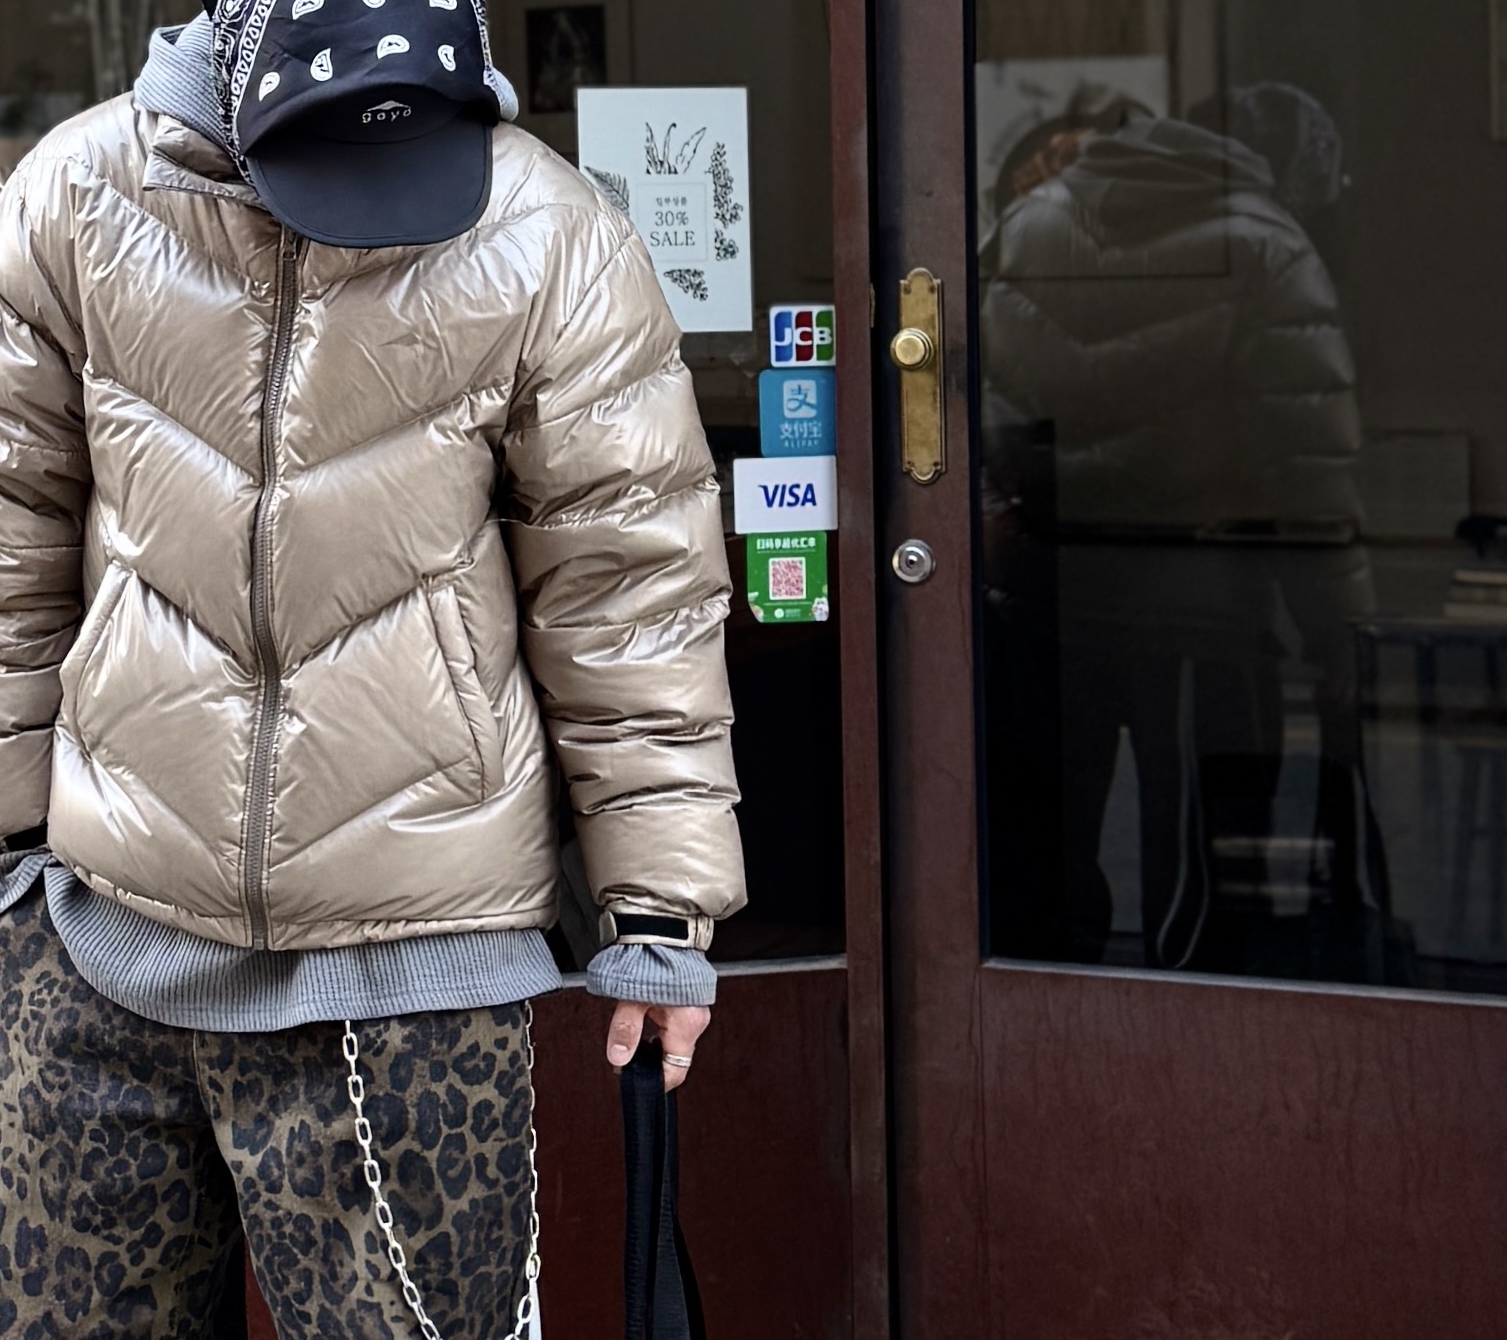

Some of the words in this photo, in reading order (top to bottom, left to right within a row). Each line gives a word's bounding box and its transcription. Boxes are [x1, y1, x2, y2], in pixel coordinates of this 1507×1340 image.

[654, 210, 690, 227] 30%
[649, 230, 696, 247] SALE
[774, 326, 833, 346] JCB
[779, 421, 822, 440] 支付宝
[758, 482, 817, 508] VISA
